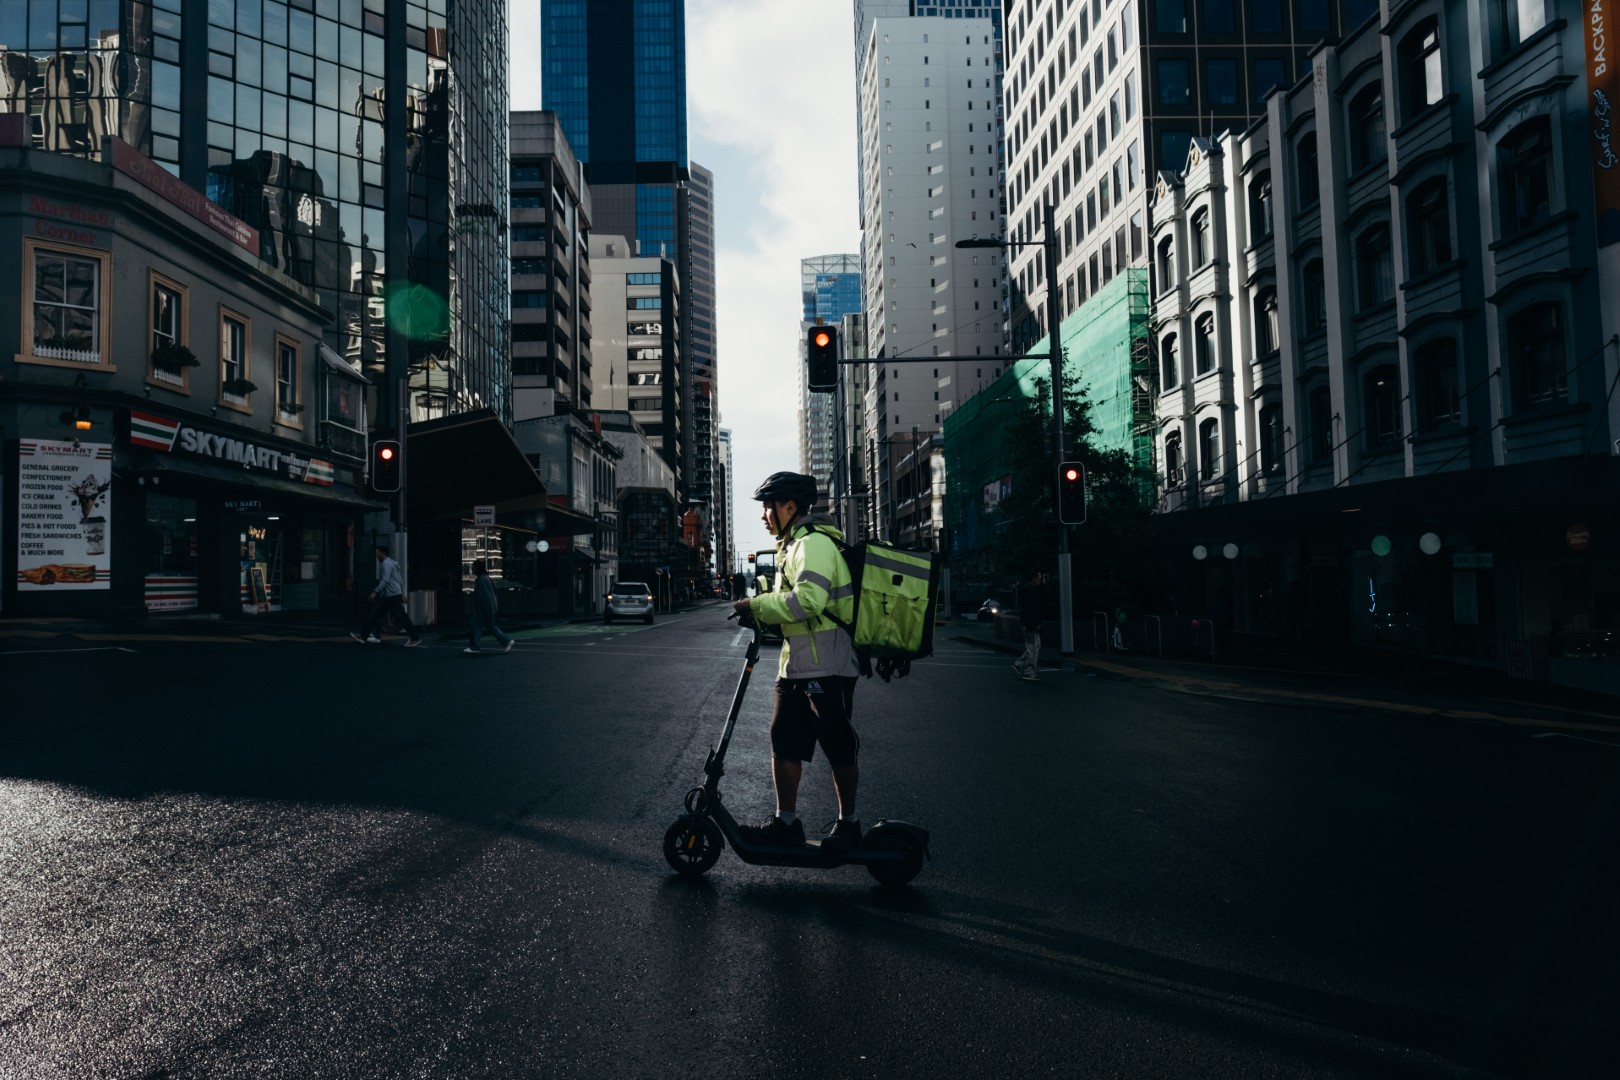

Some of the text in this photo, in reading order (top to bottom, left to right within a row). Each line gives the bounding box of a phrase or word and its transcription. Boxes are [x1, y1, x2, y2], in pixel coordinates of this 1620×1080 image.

[1591, 0, 1607, 78] BACKPA
[29, 193, 109, 225] Marthas
[206, 202, 225, 220] Famous
[34, 220, 97, 244] Corner
[210, 214, 236, 237] Restaurant
[240, 233, 248, 245] Bar
[40, 445, 94, 454] SKYMART
[180, 427, 282, 471] SKYMART
